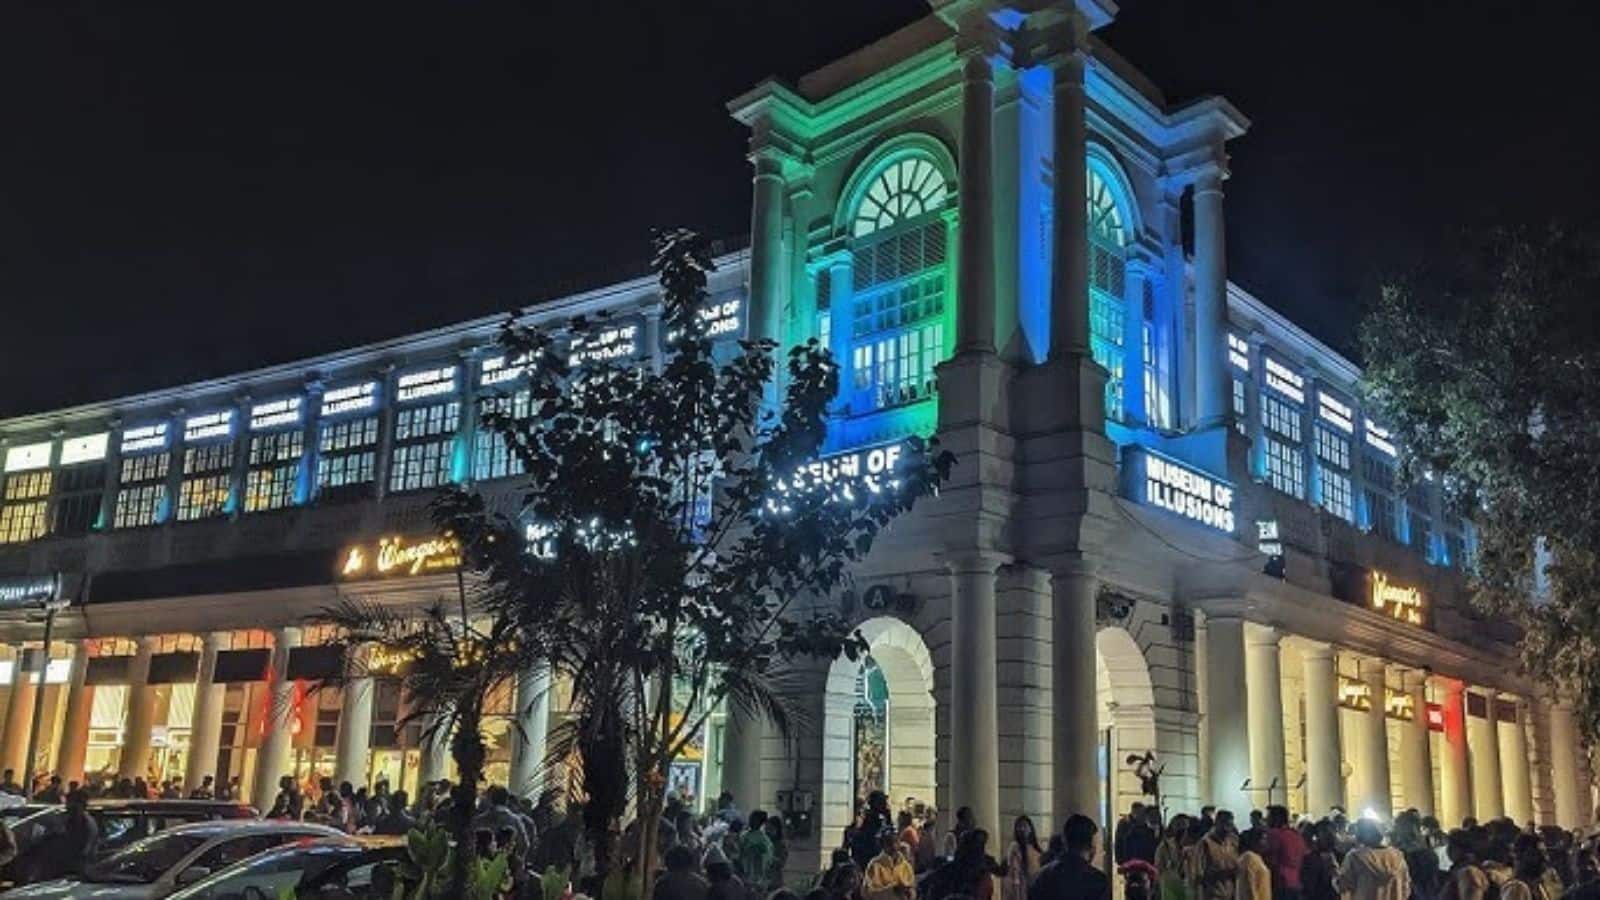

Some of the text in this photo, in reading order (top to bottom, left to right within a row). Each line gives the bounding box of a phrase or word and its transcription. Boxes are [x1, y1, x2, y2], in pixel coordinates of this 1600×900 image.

[867, 445, 901, 473] OF
[1146, 454, 1233, 510] MUSEUM OF
[1147, 479, 1235, 533] ILLUSIONS
